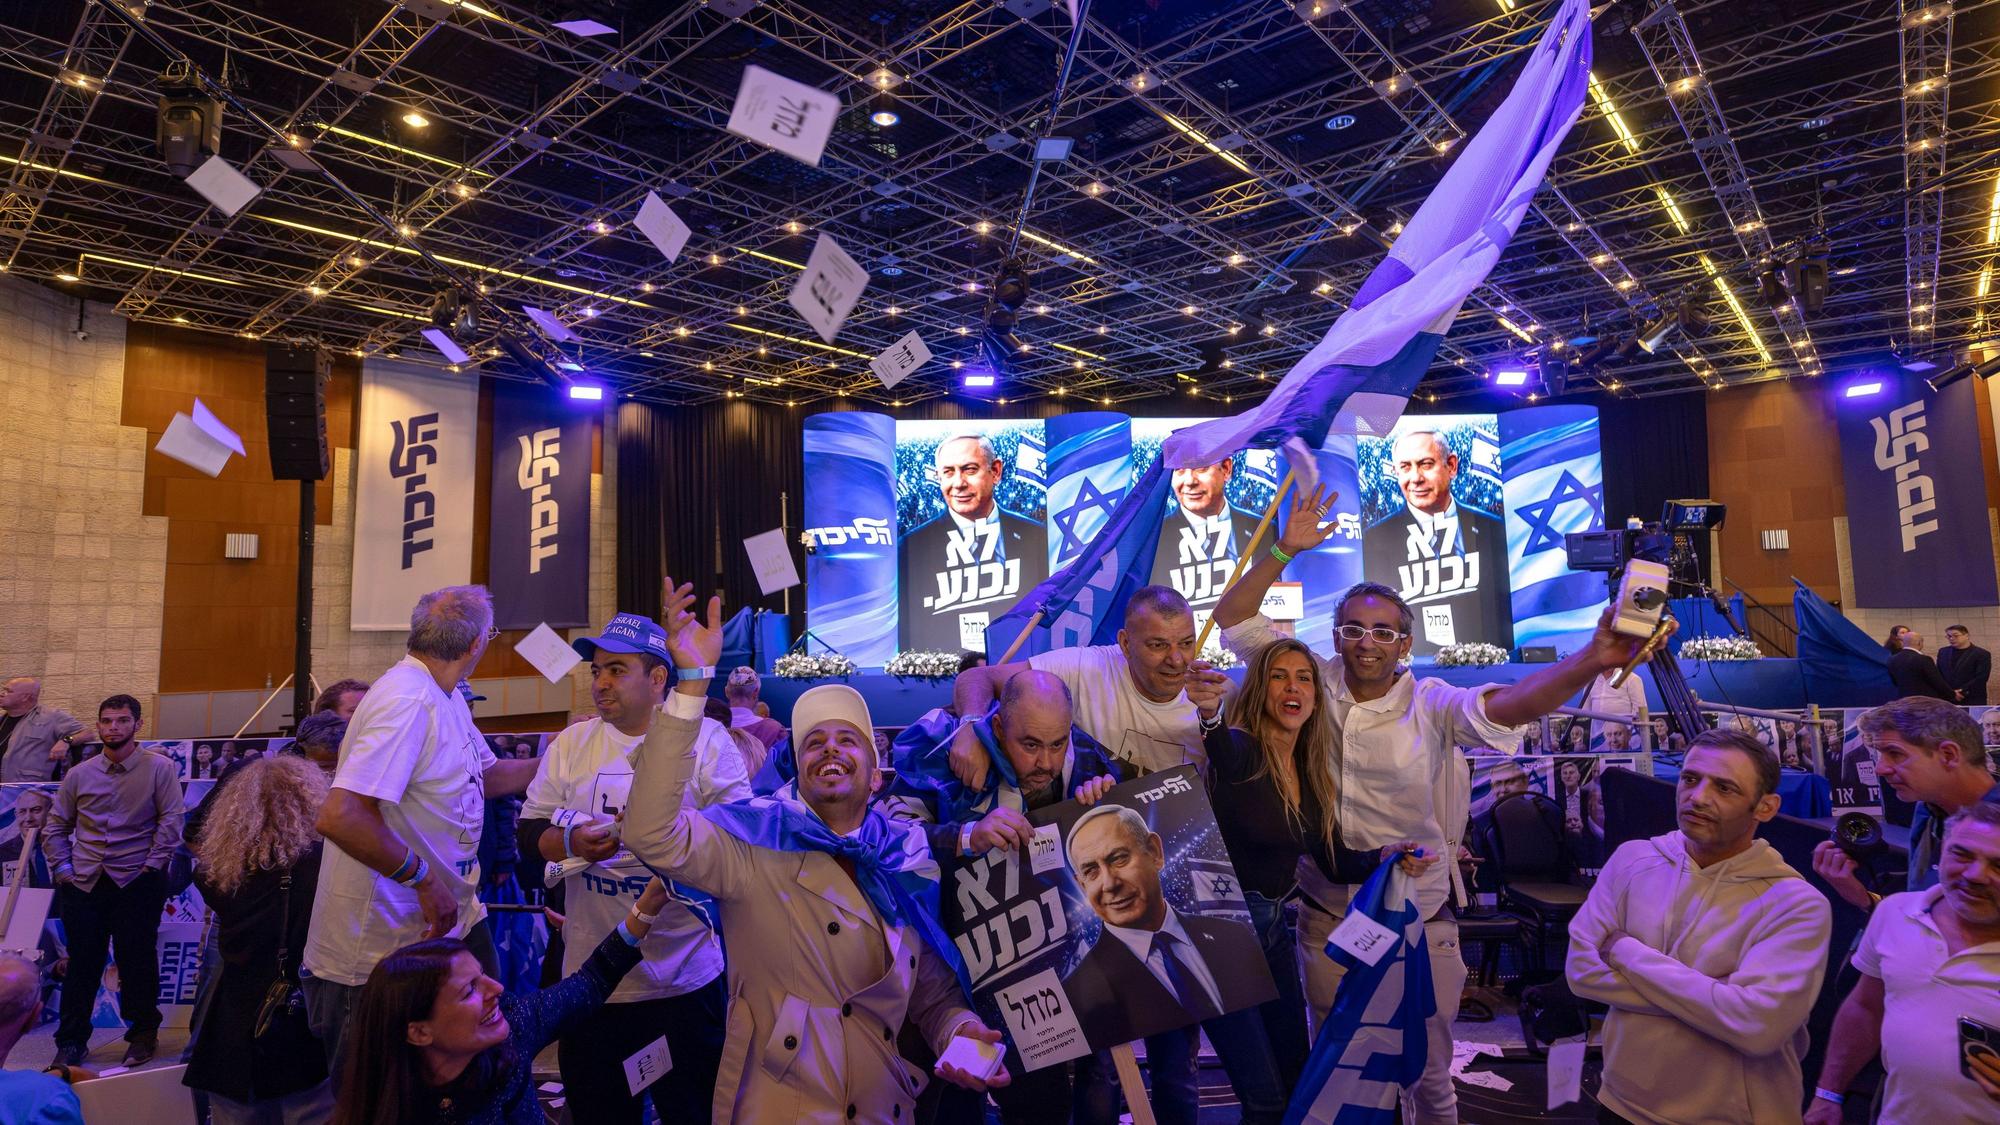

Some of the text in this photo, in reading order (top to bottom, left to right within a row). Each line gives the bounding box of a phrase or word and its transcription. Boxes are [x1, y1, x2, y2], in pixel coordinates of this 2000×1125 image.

[892, 340, 915, 370] מחל
[389, 412, 440, 570] הליכוד
[517, 426, 561, 574] הליכוד
[1869, 399, 1939, 553] הליכוד
[946, 518, 1002, 568] לא
[1178, 514, 1232, 565] לא
[1406, 511, 1459, 562] לא
[1398, 551, 1480, 602] נכנע
[608, 624, 638, 640] AGAIN
[613, 616, 641, 630] ISRAEL
[1426, 609, 1450, 627] מחל
[1134, 775, 1193, 804] הליכוד
[581, 872, 653, 900] ליכוד
[953, 847, 1021, 923] לא
[954, 887, 1068, 985] נכנע
[1003, 987, 1062, 1030] מחל
[636, 1054, 656, 1086] מחל
